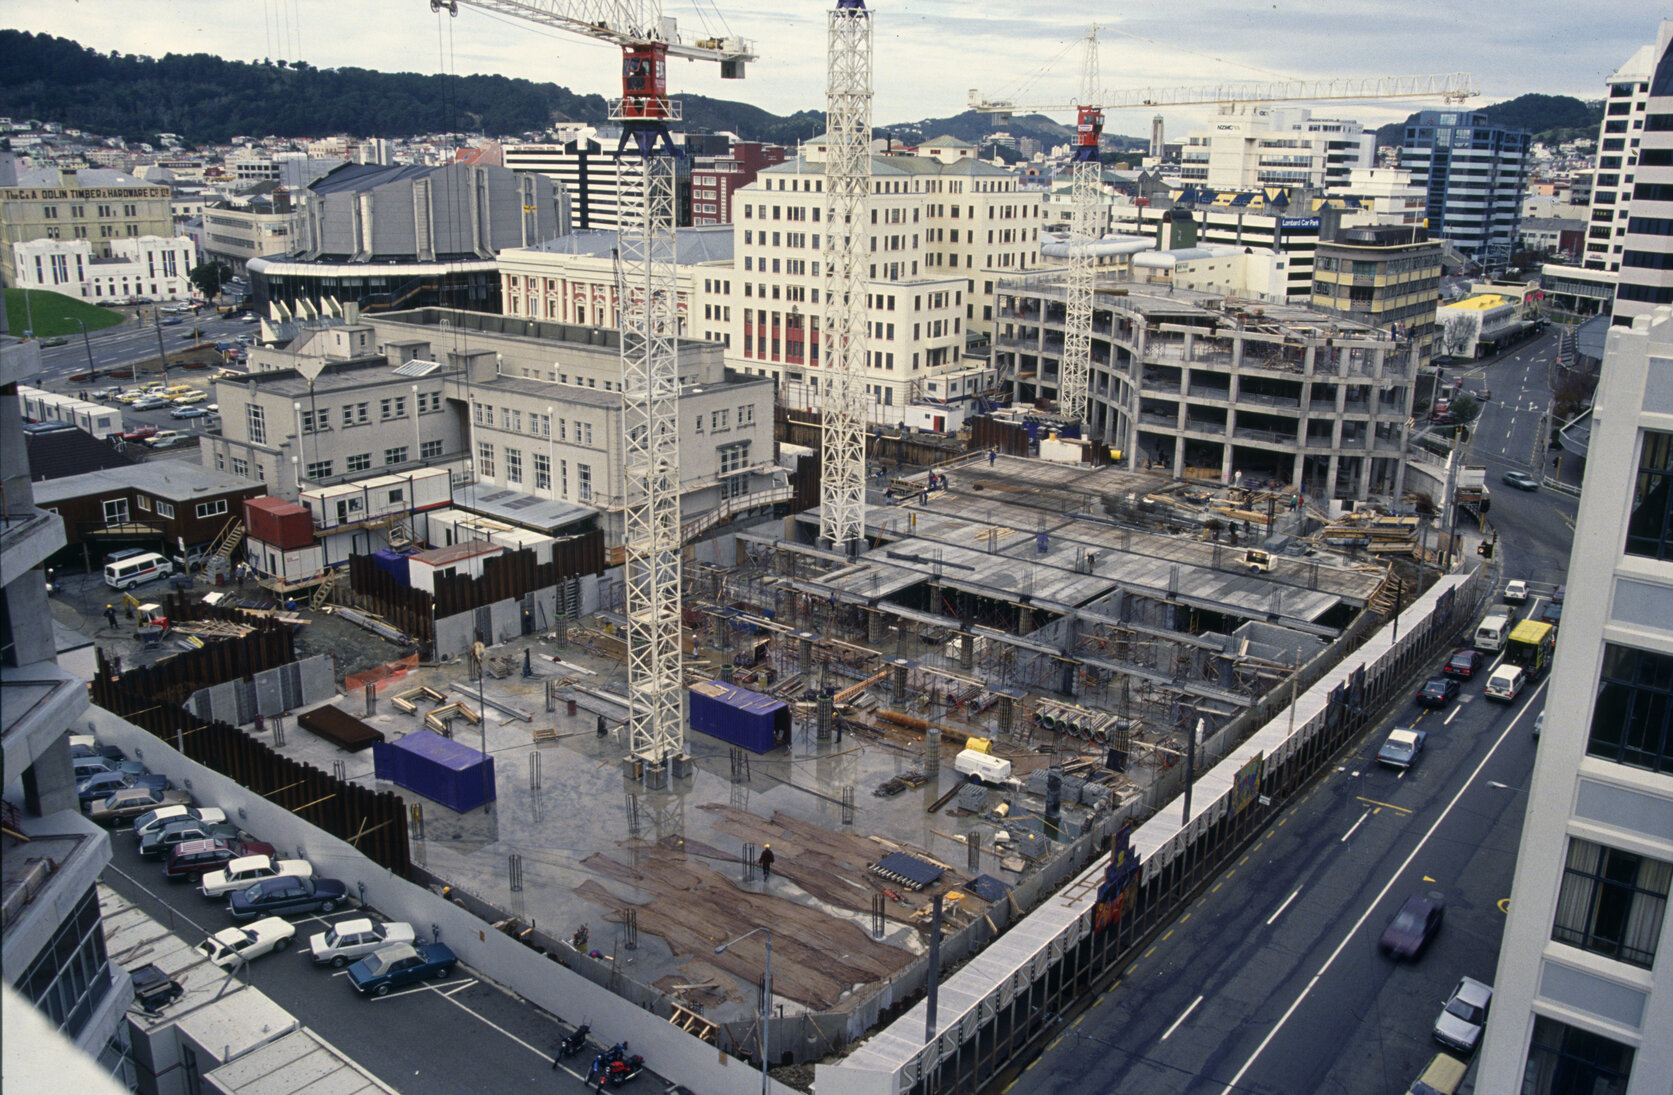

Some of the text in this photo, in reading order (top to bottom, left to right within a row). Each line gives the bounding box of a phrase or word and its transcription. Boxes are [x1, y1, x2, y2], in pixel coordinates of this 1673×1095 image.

[5, 190, 18, 200] The
[19, 190, 24, 199] C
[32, 190, 37, 199] A
[42, 190, 68, 199] ODLIN
[70, 189, 101, 199] TIMBER
[107, 188, 148, 198] HARDWARE
